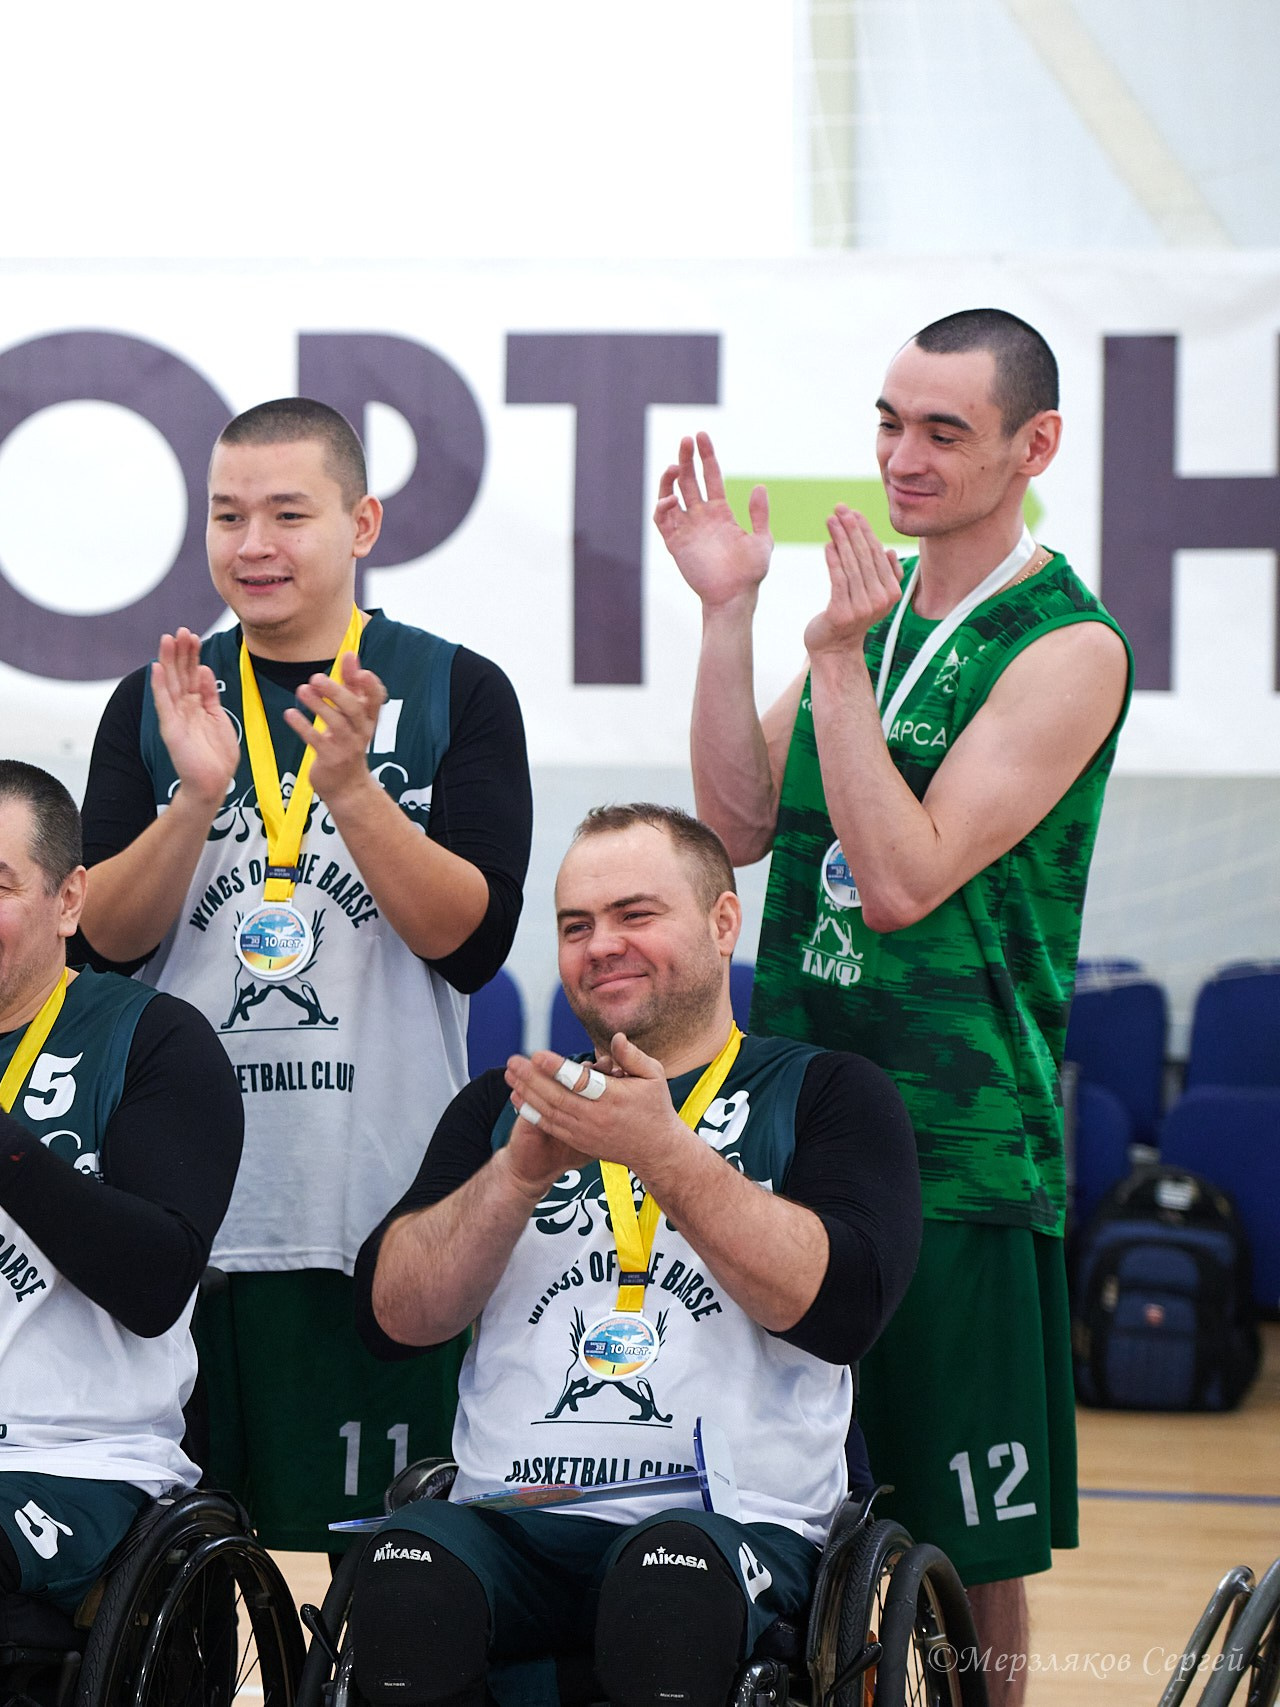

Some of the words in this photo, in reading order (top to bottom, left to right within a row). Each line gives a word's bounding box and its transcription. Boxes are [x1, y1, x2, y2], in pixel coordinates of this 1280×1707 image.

[888, 719, 949, 749] АРСА
[189, 867, 245, 932] WINGS
[316, 861, 379, 929] BARSE
[264, 936, 277, 948] 10
[23, 1051, 84, 1121] 5
[232, 1061, 308, 1094] ETBALL
[698, 1089, 751, 1151] 9
[660, 1259, 723, 1323] BARSE
[610, 1343, 624, 1355] 10
[339, 1421, 409, 1496] 11
[949, 1441, 1037, 1527] 12
[373, 1541, 433, 1563] MIKASA
[642, 1546, 708, 1571] MIKASA
